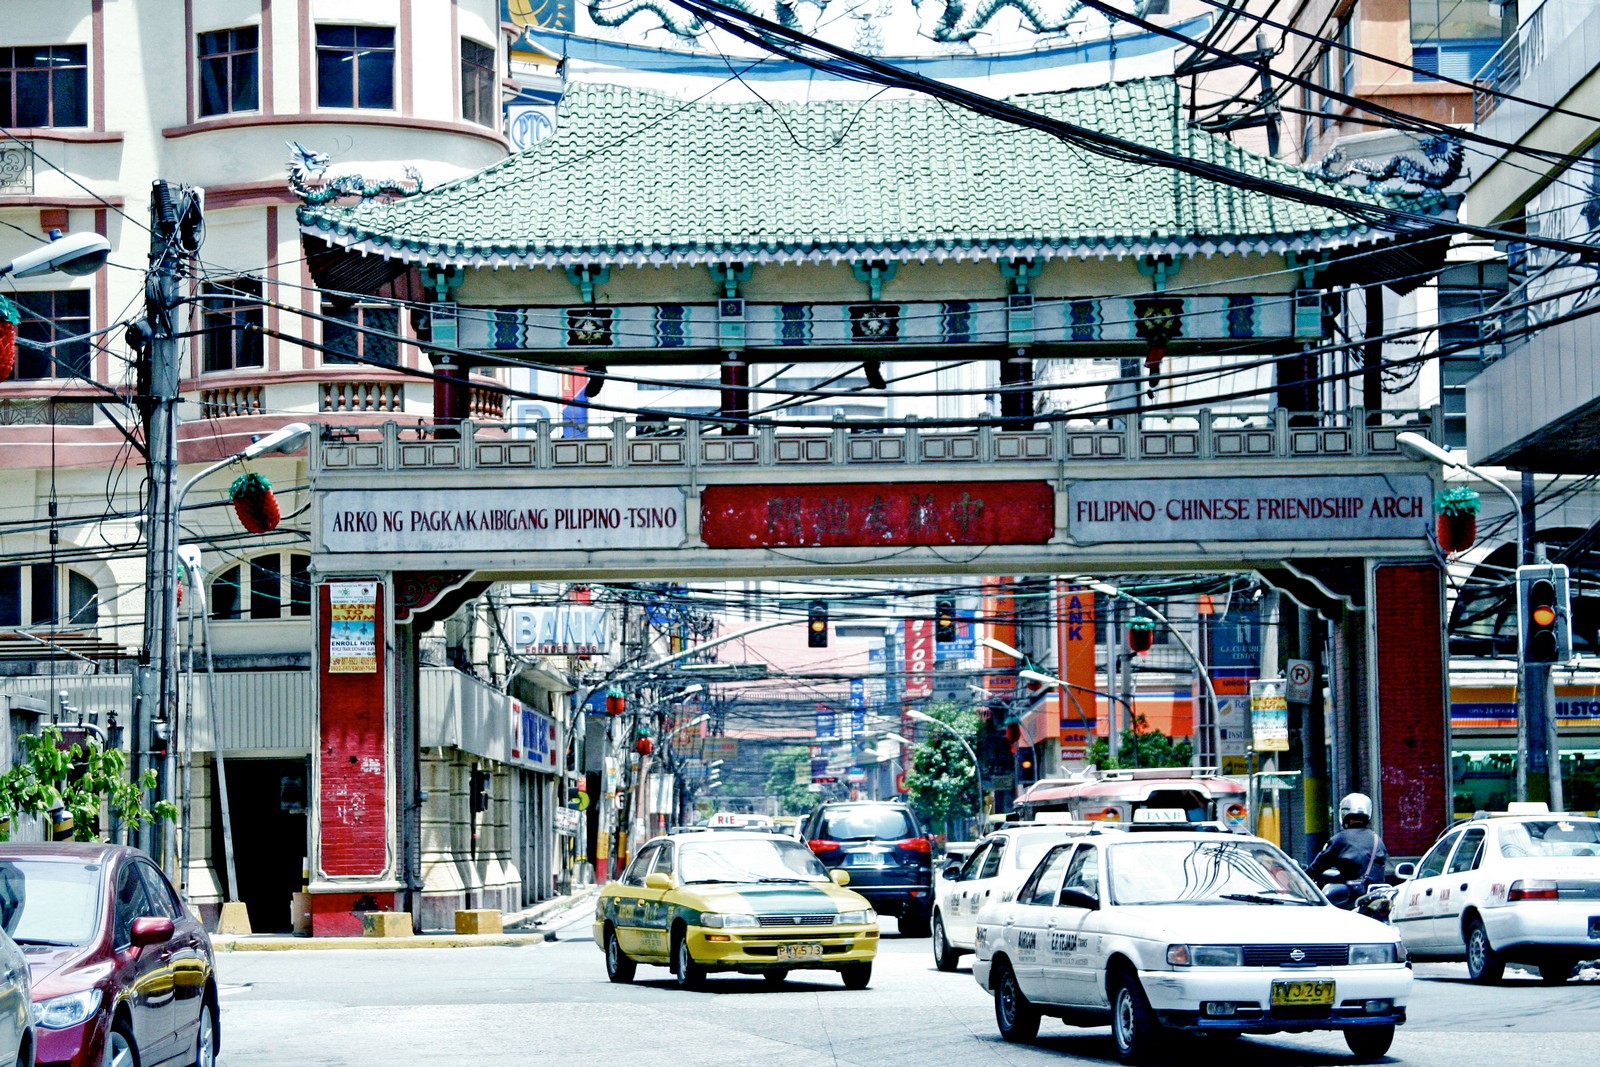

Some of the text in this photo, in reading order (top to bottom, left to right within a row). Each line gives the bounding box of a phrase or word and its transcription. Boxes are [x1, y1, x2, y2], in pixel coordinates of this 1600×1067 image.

[1256, 496, 1363, 521] FRIENDSHIP
[1369, 496, 1423, 519] ARCH
[332, 510, 378, 533] ARKO
[383, 510, 403, 532] NG
[410, 508, 548, 532] PAGKAKAIBIGANG
[515, 610, 606, 645] BANK
[525, 645, 597, 654] FOUNDED 1916
[1485, 707, 1494, 715] 24
[1018, 930, 1037, 949] AIRCON
[1304, 982, 1333, 998] 267
